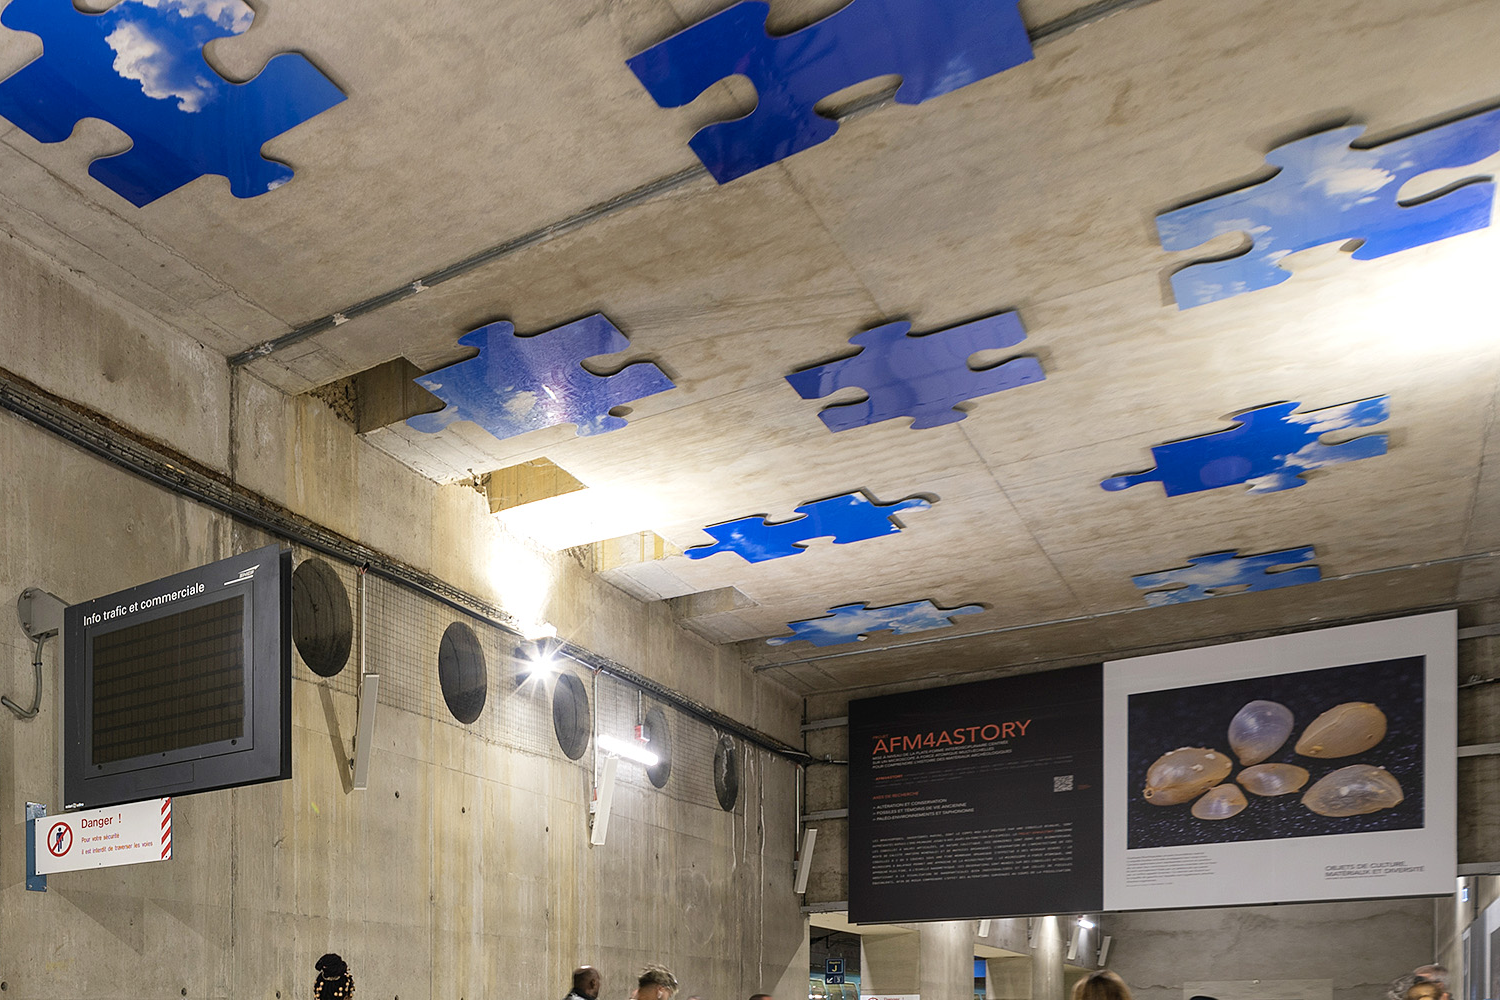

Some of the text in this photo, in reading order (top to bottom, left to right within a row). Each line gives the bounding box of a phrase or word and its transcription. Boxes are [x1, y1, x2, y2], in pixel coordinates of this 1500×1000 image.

[83, 582, 205, 627] Info trafic et commerciale
[872, 719, 1032, 755] AFM4ASTORY
[81, 816, 113, 829] Danger
[92, 846, 107, 854] interdit
[114, 843, 132, 851] traverser
[141, 840, 153, 848] voies
